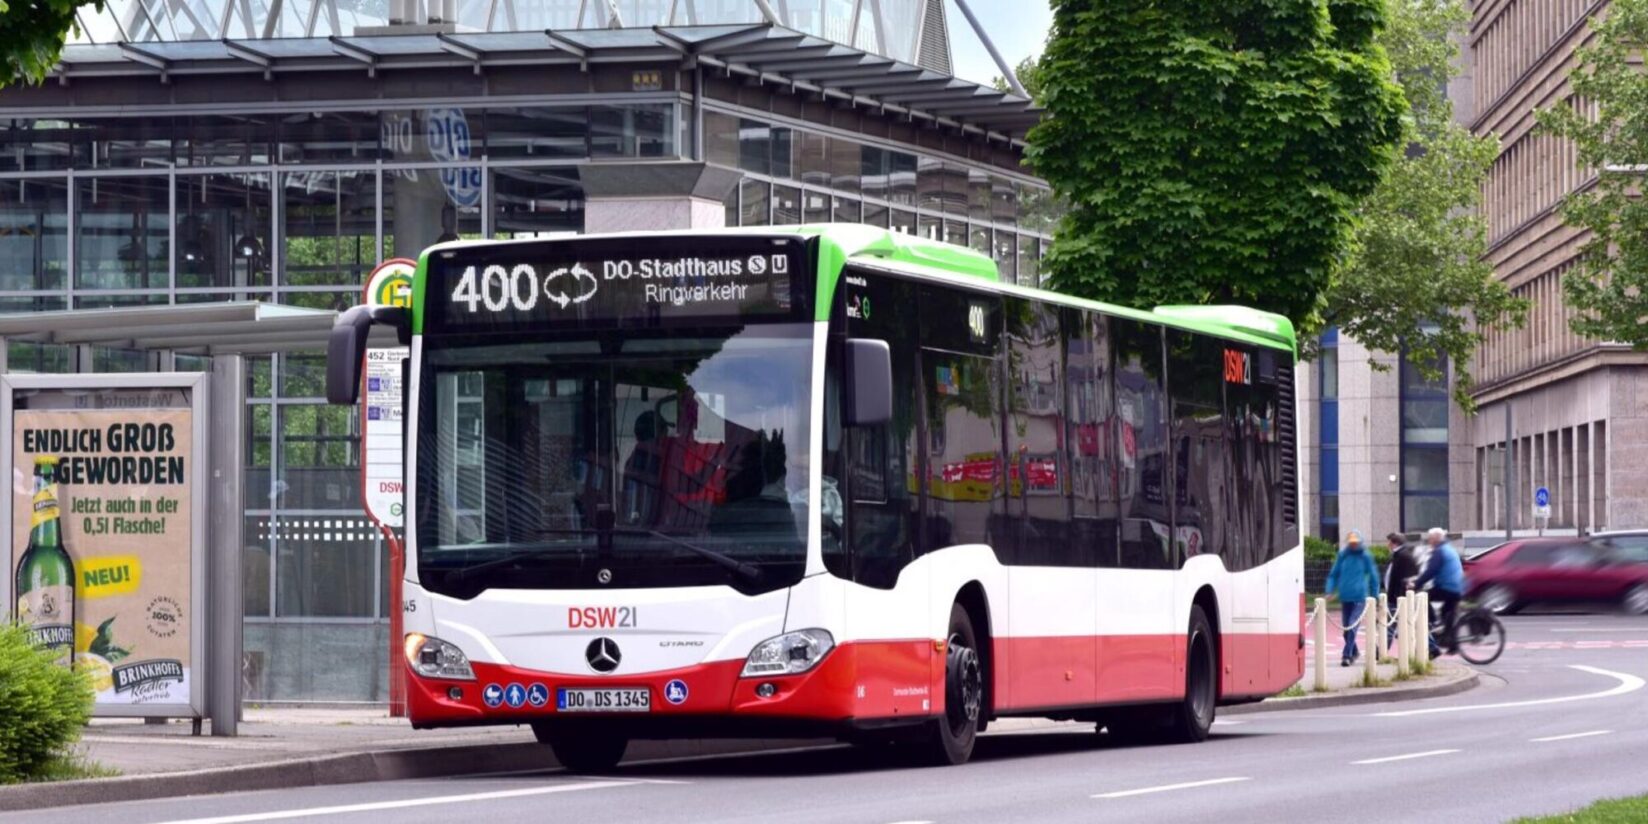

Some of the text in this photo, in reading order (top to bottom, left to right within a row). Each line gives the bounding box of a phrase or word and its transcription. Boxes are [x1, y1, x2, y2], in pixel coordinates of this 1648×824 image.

[603, 257, 743, 281] DO-Stadthaus
[451, 263, 539, 313] 400
[645, 281, 749, 306] Ringverkehr
[368, 351, 384, 361] 452
[24, 423, 175, 453] ENDLICH GROß
[57, 456, 184, 485] GEWORDEN
[71, 497, 101, 514] Jetzt
[105, 497, 136, 514] auch
[139, 496, 150, 513] in
[156, 496, 179, 513] der
[113, 517, 166, 534] Flasche!
[84, 565, 130, 588] NEU!
[152, 611, 177, 623] 100%
[568, 606, 637, 629] DSW21
[567, 691, 649, 707] DO DS 1345
